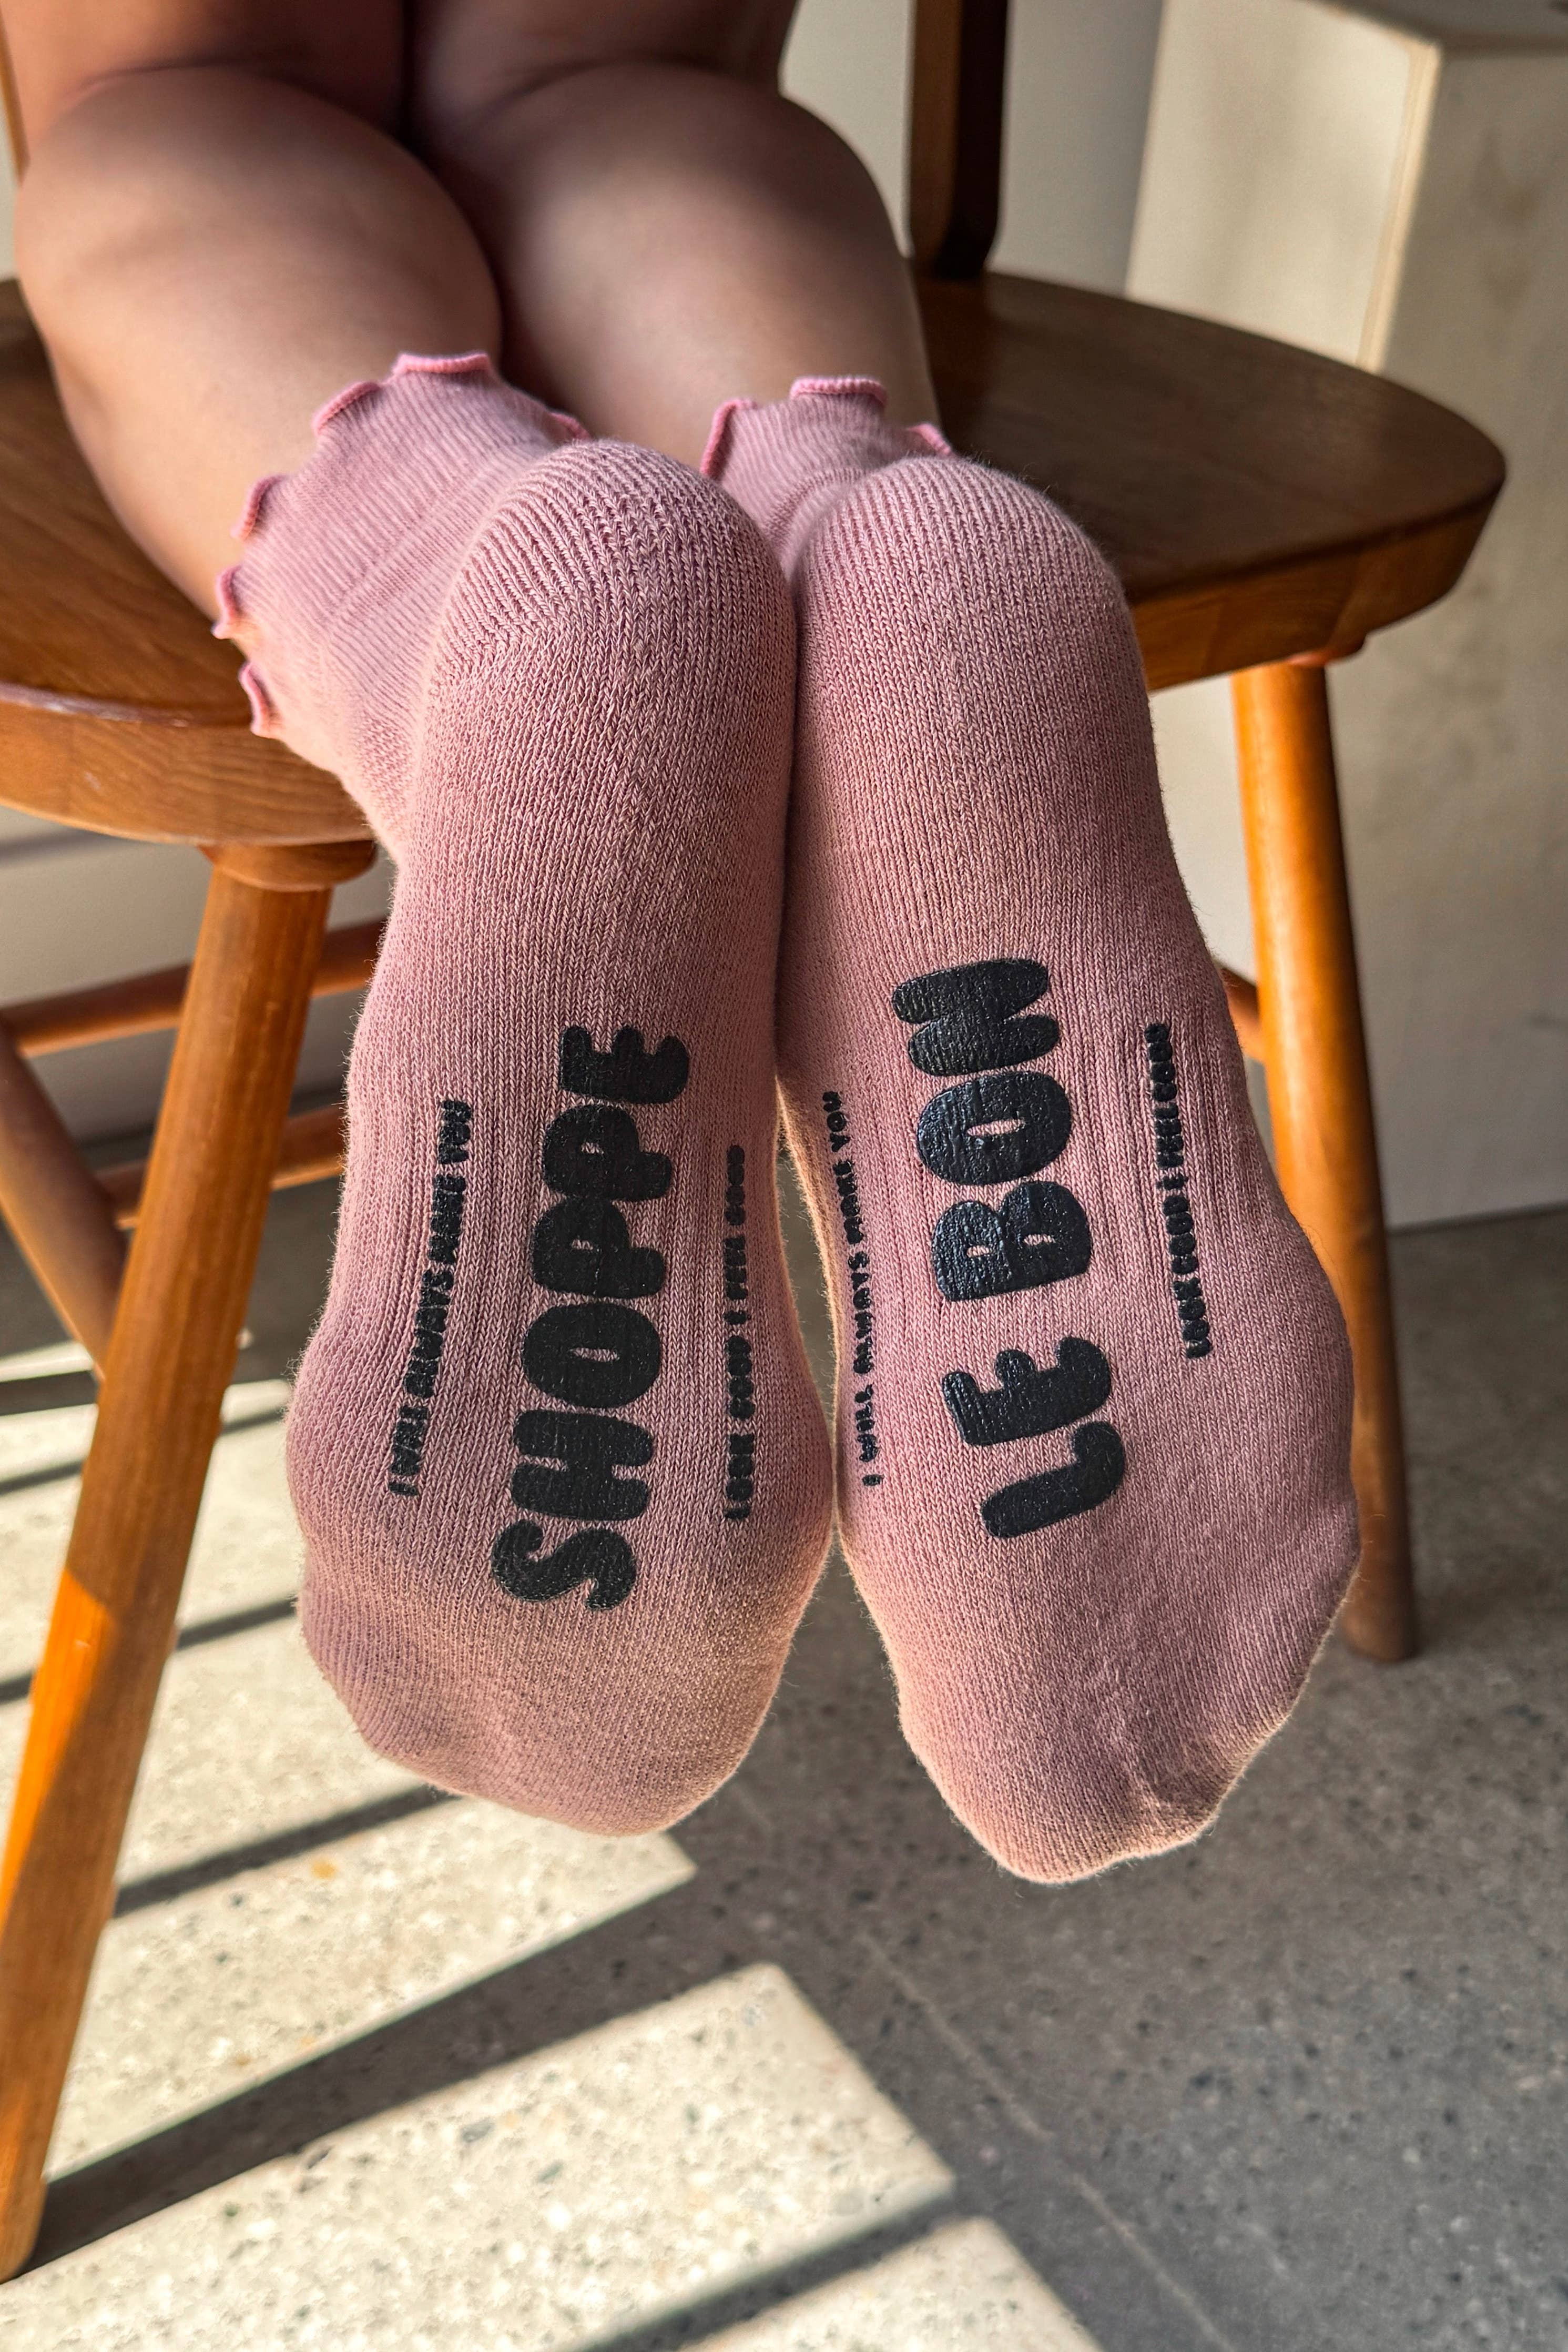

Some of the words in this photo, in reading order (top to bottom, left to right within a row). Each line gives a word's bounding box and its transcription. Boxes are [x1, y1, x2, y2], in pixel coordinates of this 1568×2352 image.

[1144, 1023, 1178, 1102] GOOD
[437, 1100, 472, 1164] YOU
[822, 1090, 850, 1152] YOU
[894, 959, 1092, 1301] BON
[1155, 1104, 1184, 1168] FEEL
[832, 1159, 865, 1244] MAKE
[1163, 1194, 1199, 1274] GOOD
[723, 1235, 749, 1301] FEEL
[403, 1269, 454, 1398] ALWAYS
[493, 1024, 693, 1609] SHOPPE
[848, 1251, 873, 1374] ALWAYS
[1174, 1278, 1213, 1359] LOOK
[725, 1335, 756, 1420] GOOD
[390, 1405, 429, 1476] WILL
[854, 1384, 878, 1462] WILL
[945, 1337, 1127, 1539] LE
[388, 1481, 419, 1496] I
[724, 1433, 756, 1520] LOOK
[862, 1473, 884, 1486] I
